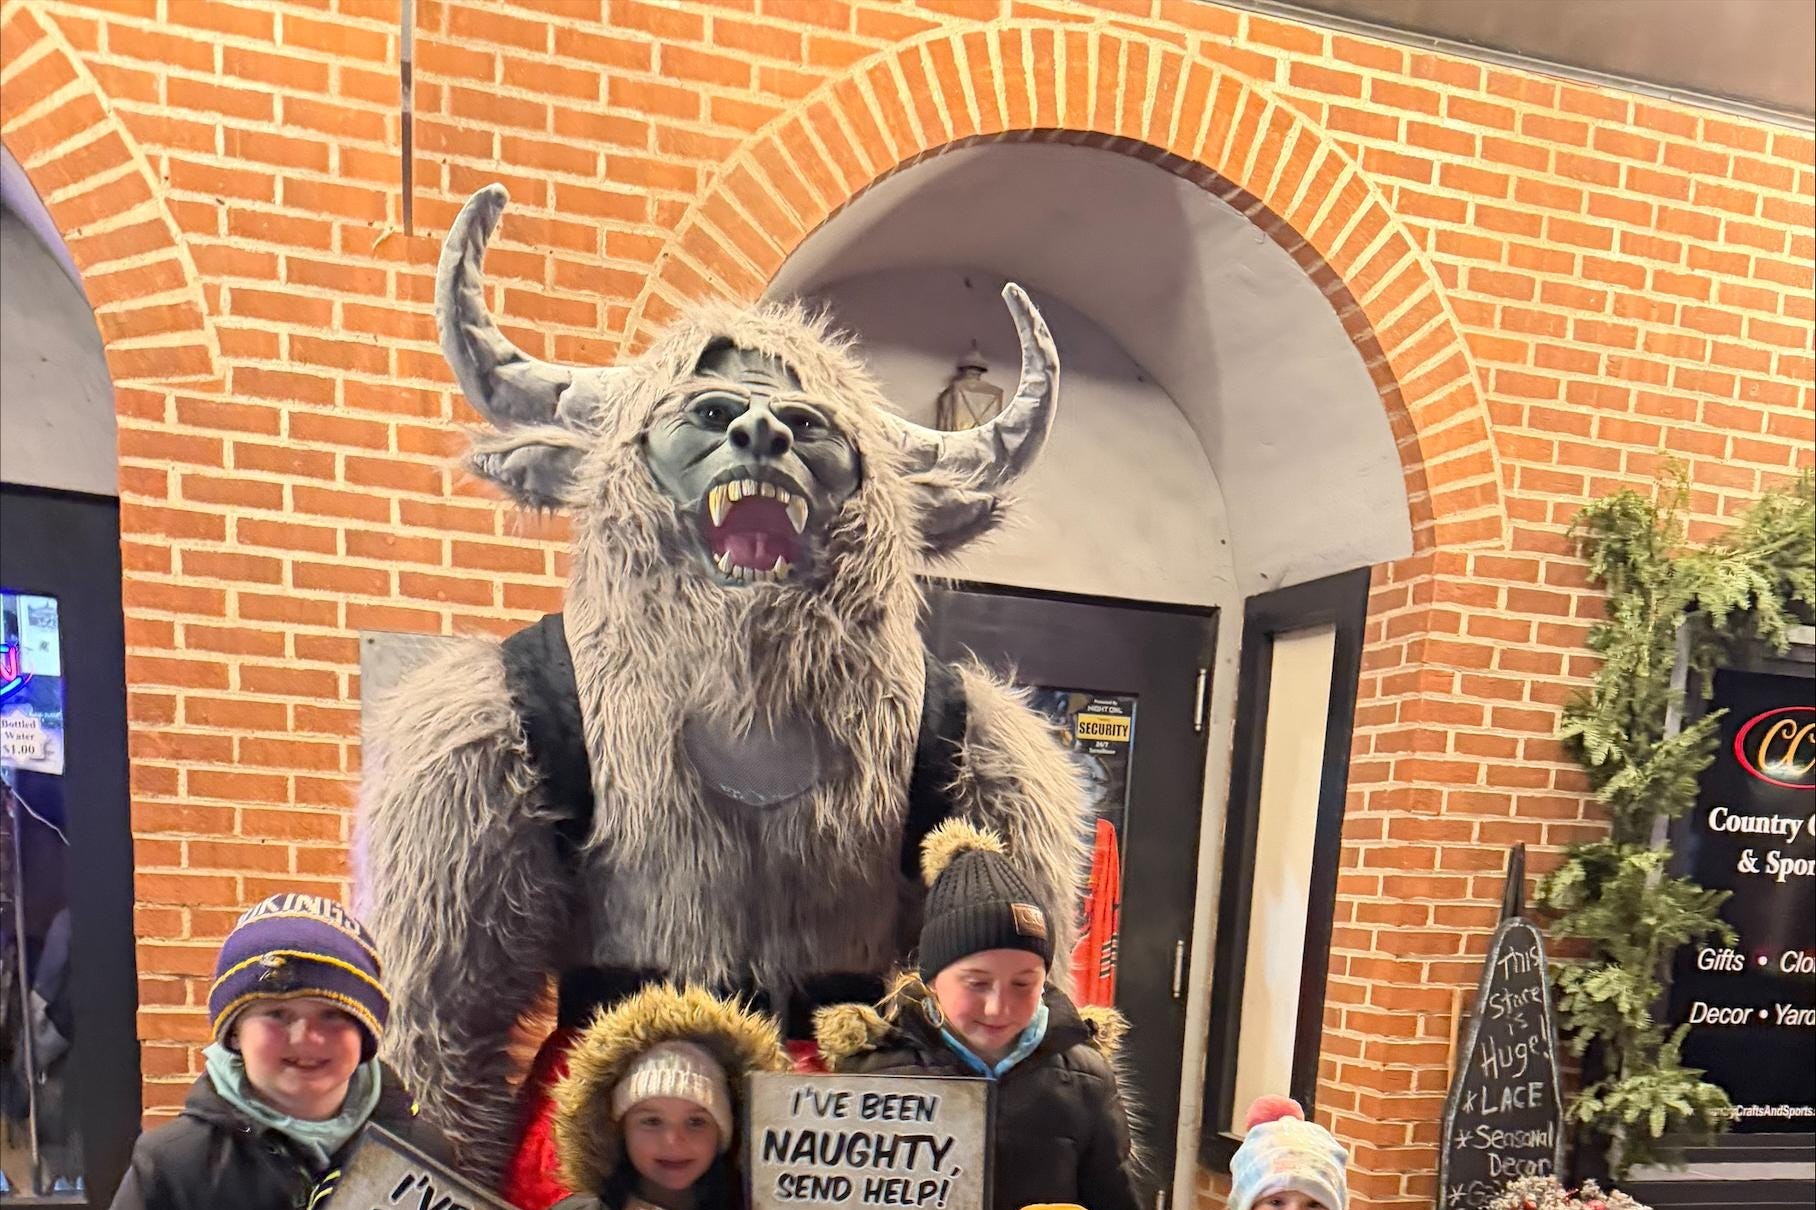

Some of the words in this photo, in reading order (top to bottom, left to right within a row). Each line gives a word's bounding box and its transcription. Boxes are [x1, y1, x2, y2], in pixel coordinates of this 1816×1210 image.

[5, 730, 35, 741] Water
[1079, 721, 1129, 737] SECURITY
[1708, 806, 1804, 844] Country
[1737, 849, 1760, 873] &
[1498, 946, 1540, 981] This
[1697, 948, 1745, 971] Gifts
[1780, 950, 1815, 973] Clo
[1689, 1002, 1754, 1024] Decor
[1481, 1014, 1551, 1079] Huge!
[793, 1089, 852, 1118] I'VE
[860, 1093, 939, 1122] BEEN
[763, 1129, 962, 1177] NAUGHTY,
[777, 1173, 853, 1201] SEND
[863, 1177, 950, 1208] HELP!
